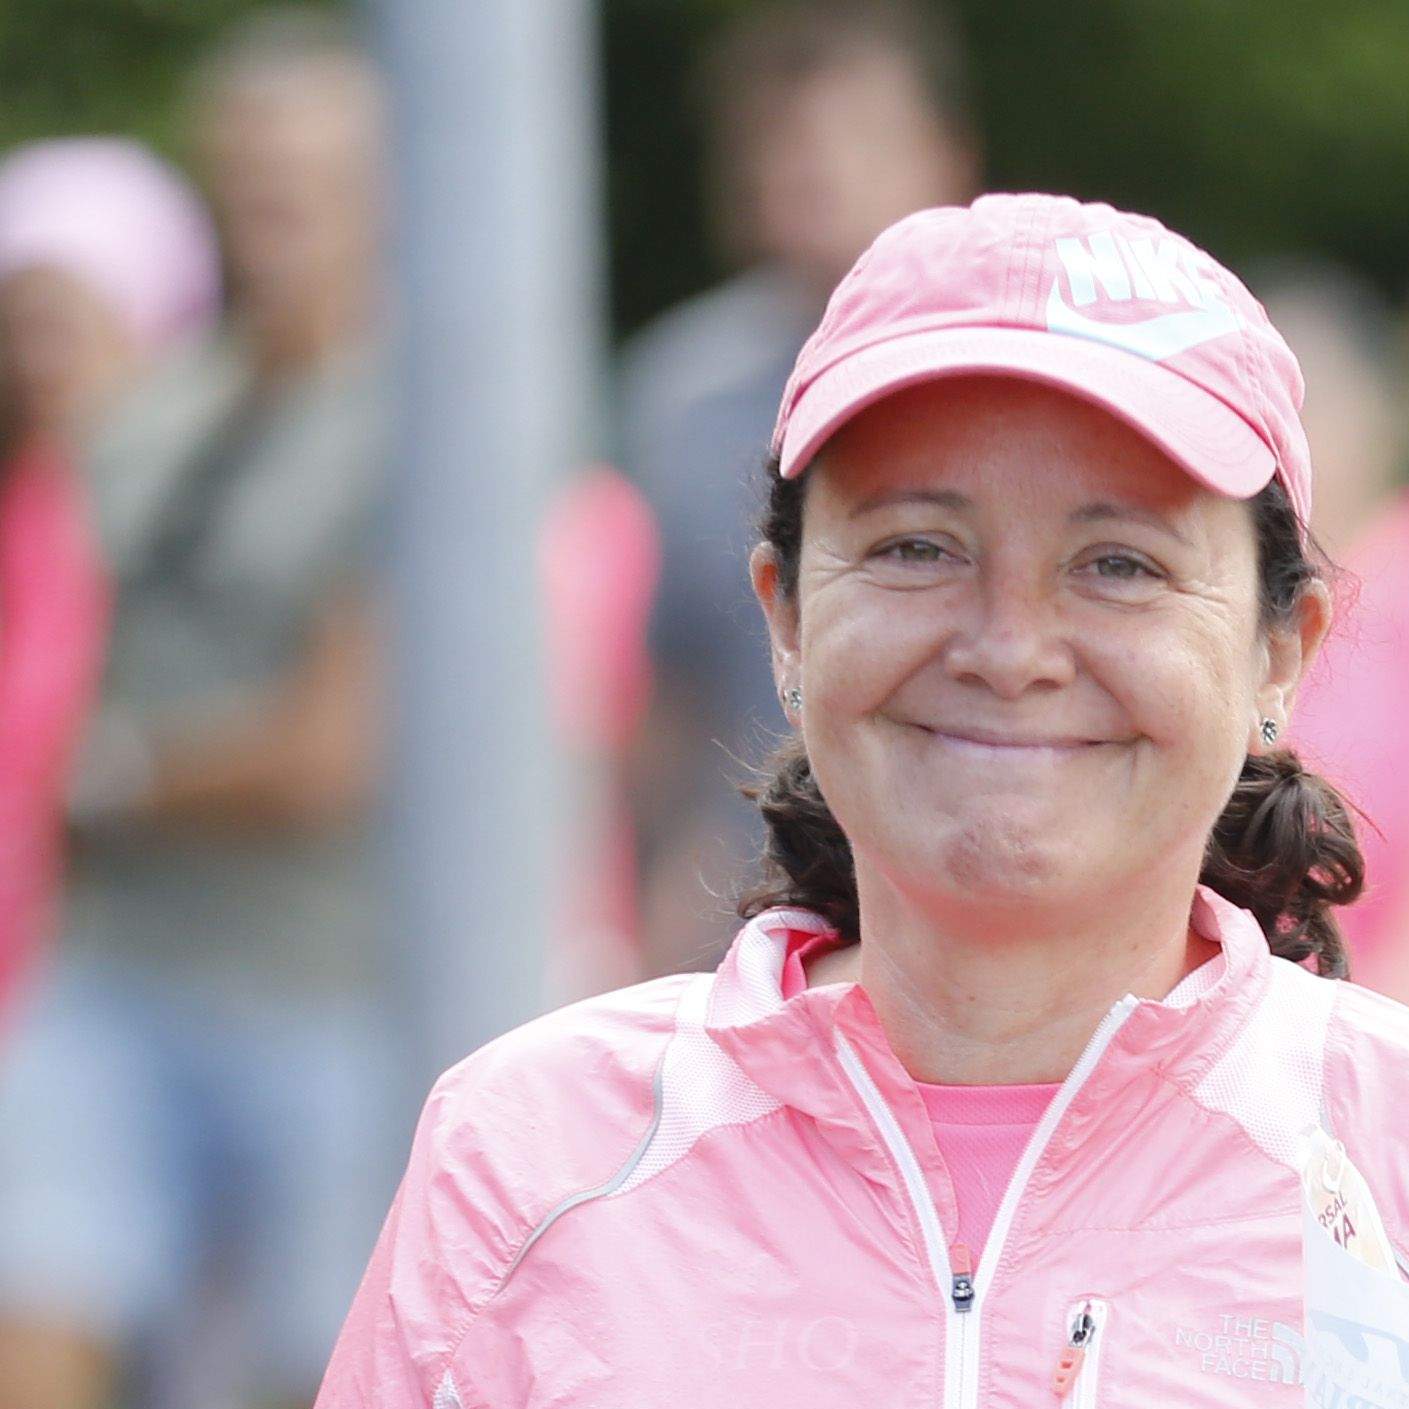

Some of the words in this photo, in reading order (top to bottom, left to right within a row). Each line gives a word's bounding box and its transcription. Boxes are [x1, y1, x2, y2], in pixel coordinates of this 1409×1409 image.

[1218, 1313, 1270, 1340] THE
[1175, 1327, 1269, 1360] NORTH
[1200, 1352, 1267, 1381] FACE
